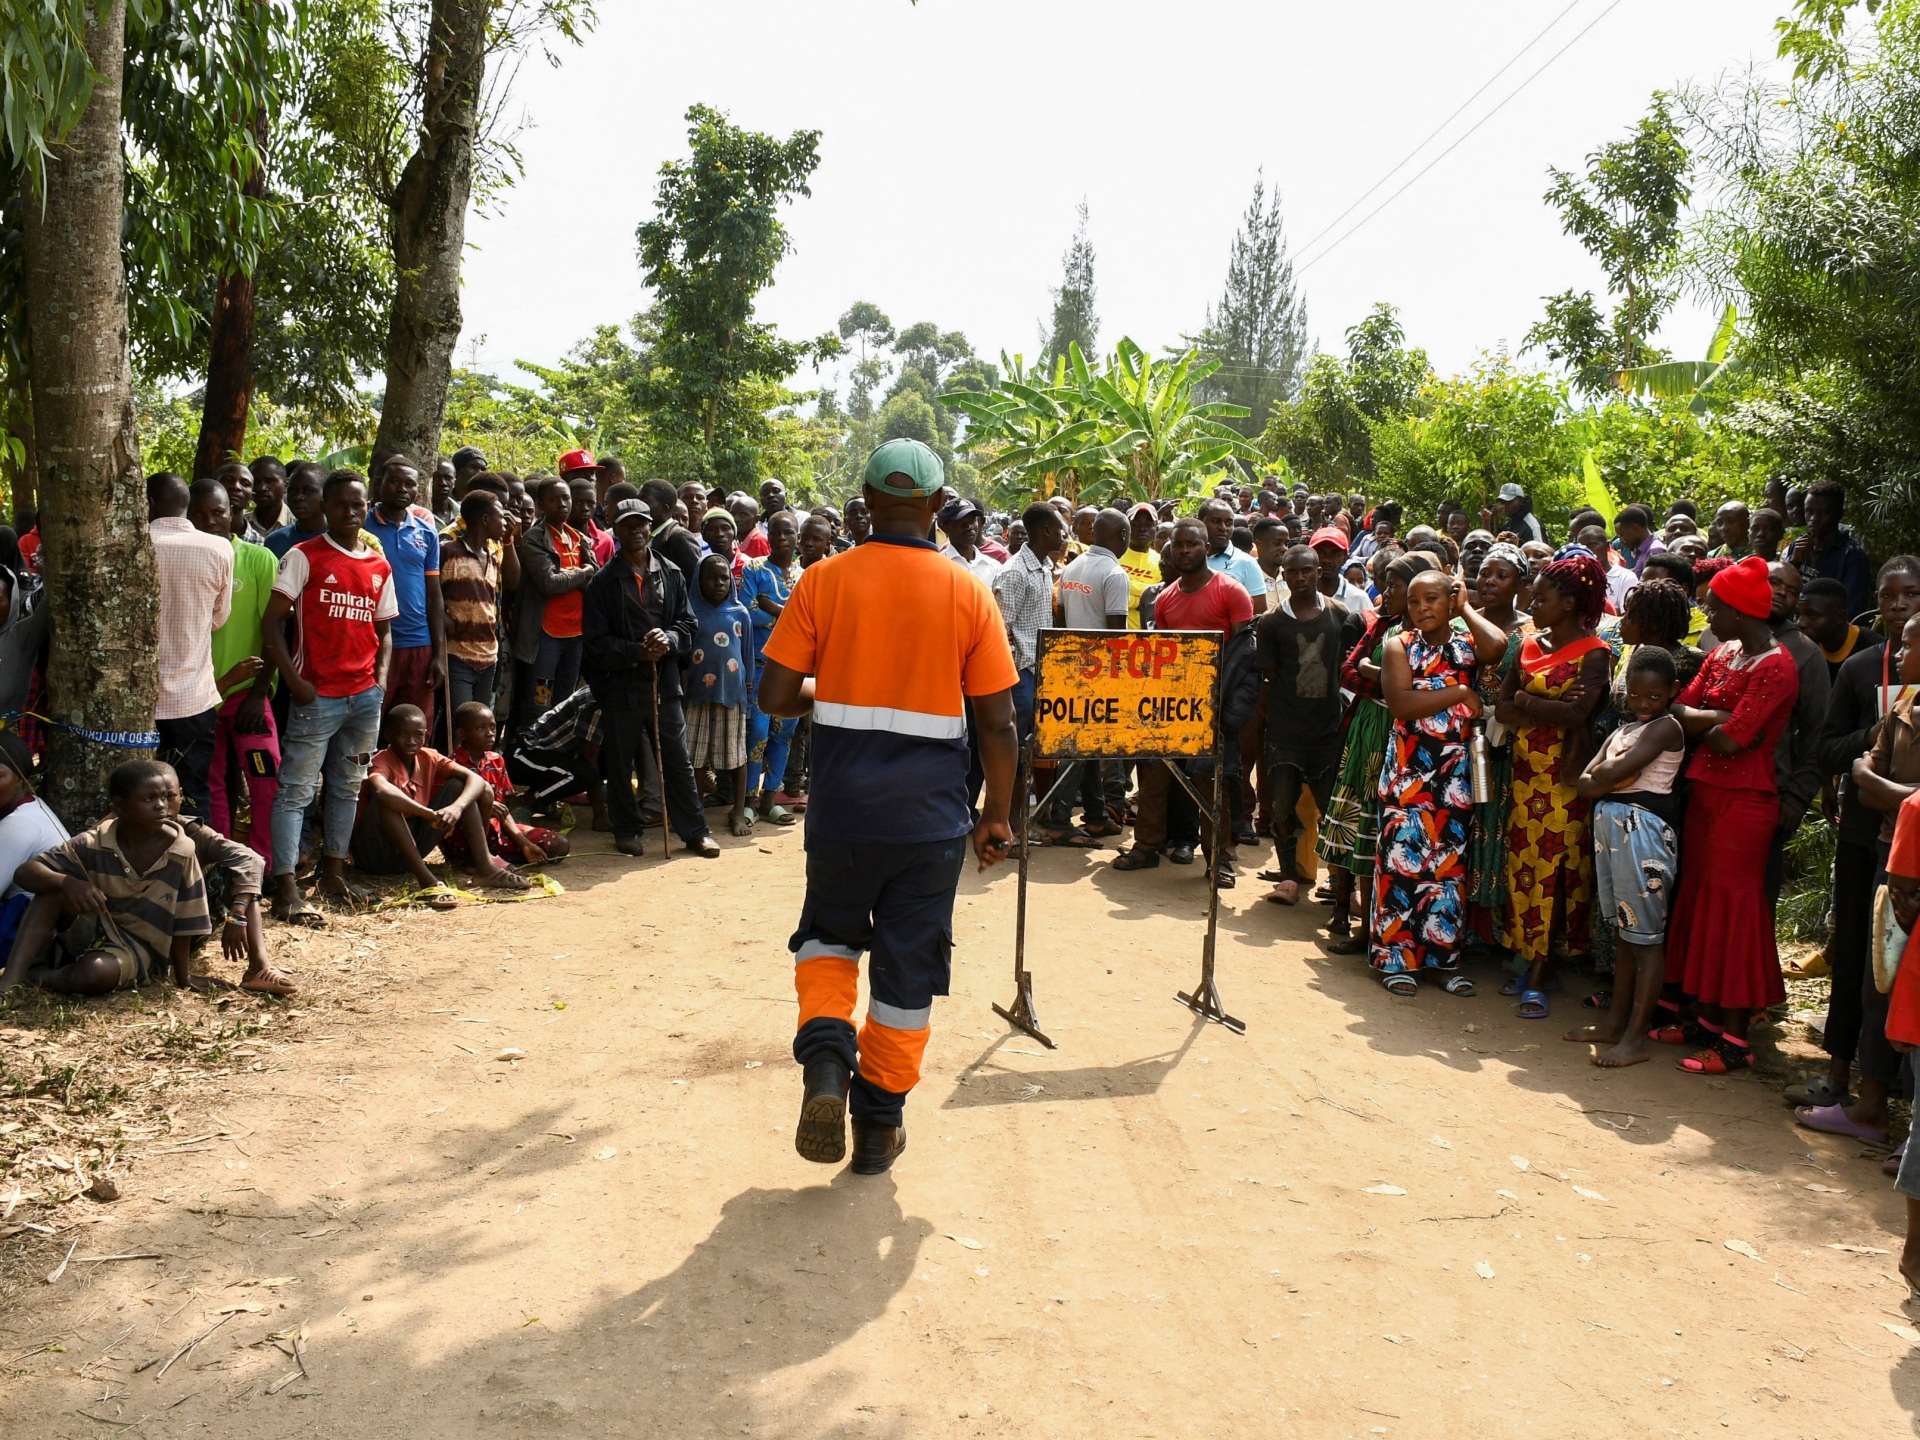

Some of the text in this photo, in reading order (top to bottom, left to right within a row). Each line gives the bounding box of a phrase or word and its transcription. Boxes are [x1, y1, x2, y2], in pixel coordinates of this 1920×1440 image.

[1120, 564, 1153, 579] DHL
[328, 605, 345, 618] FLY
[1080, 639, 1178, 680] STOP
[1039, 696, 1204, 724] POLICE CHECK
[104, 731, 126, 744] NOT
[129, 732, 141, 743] DO
